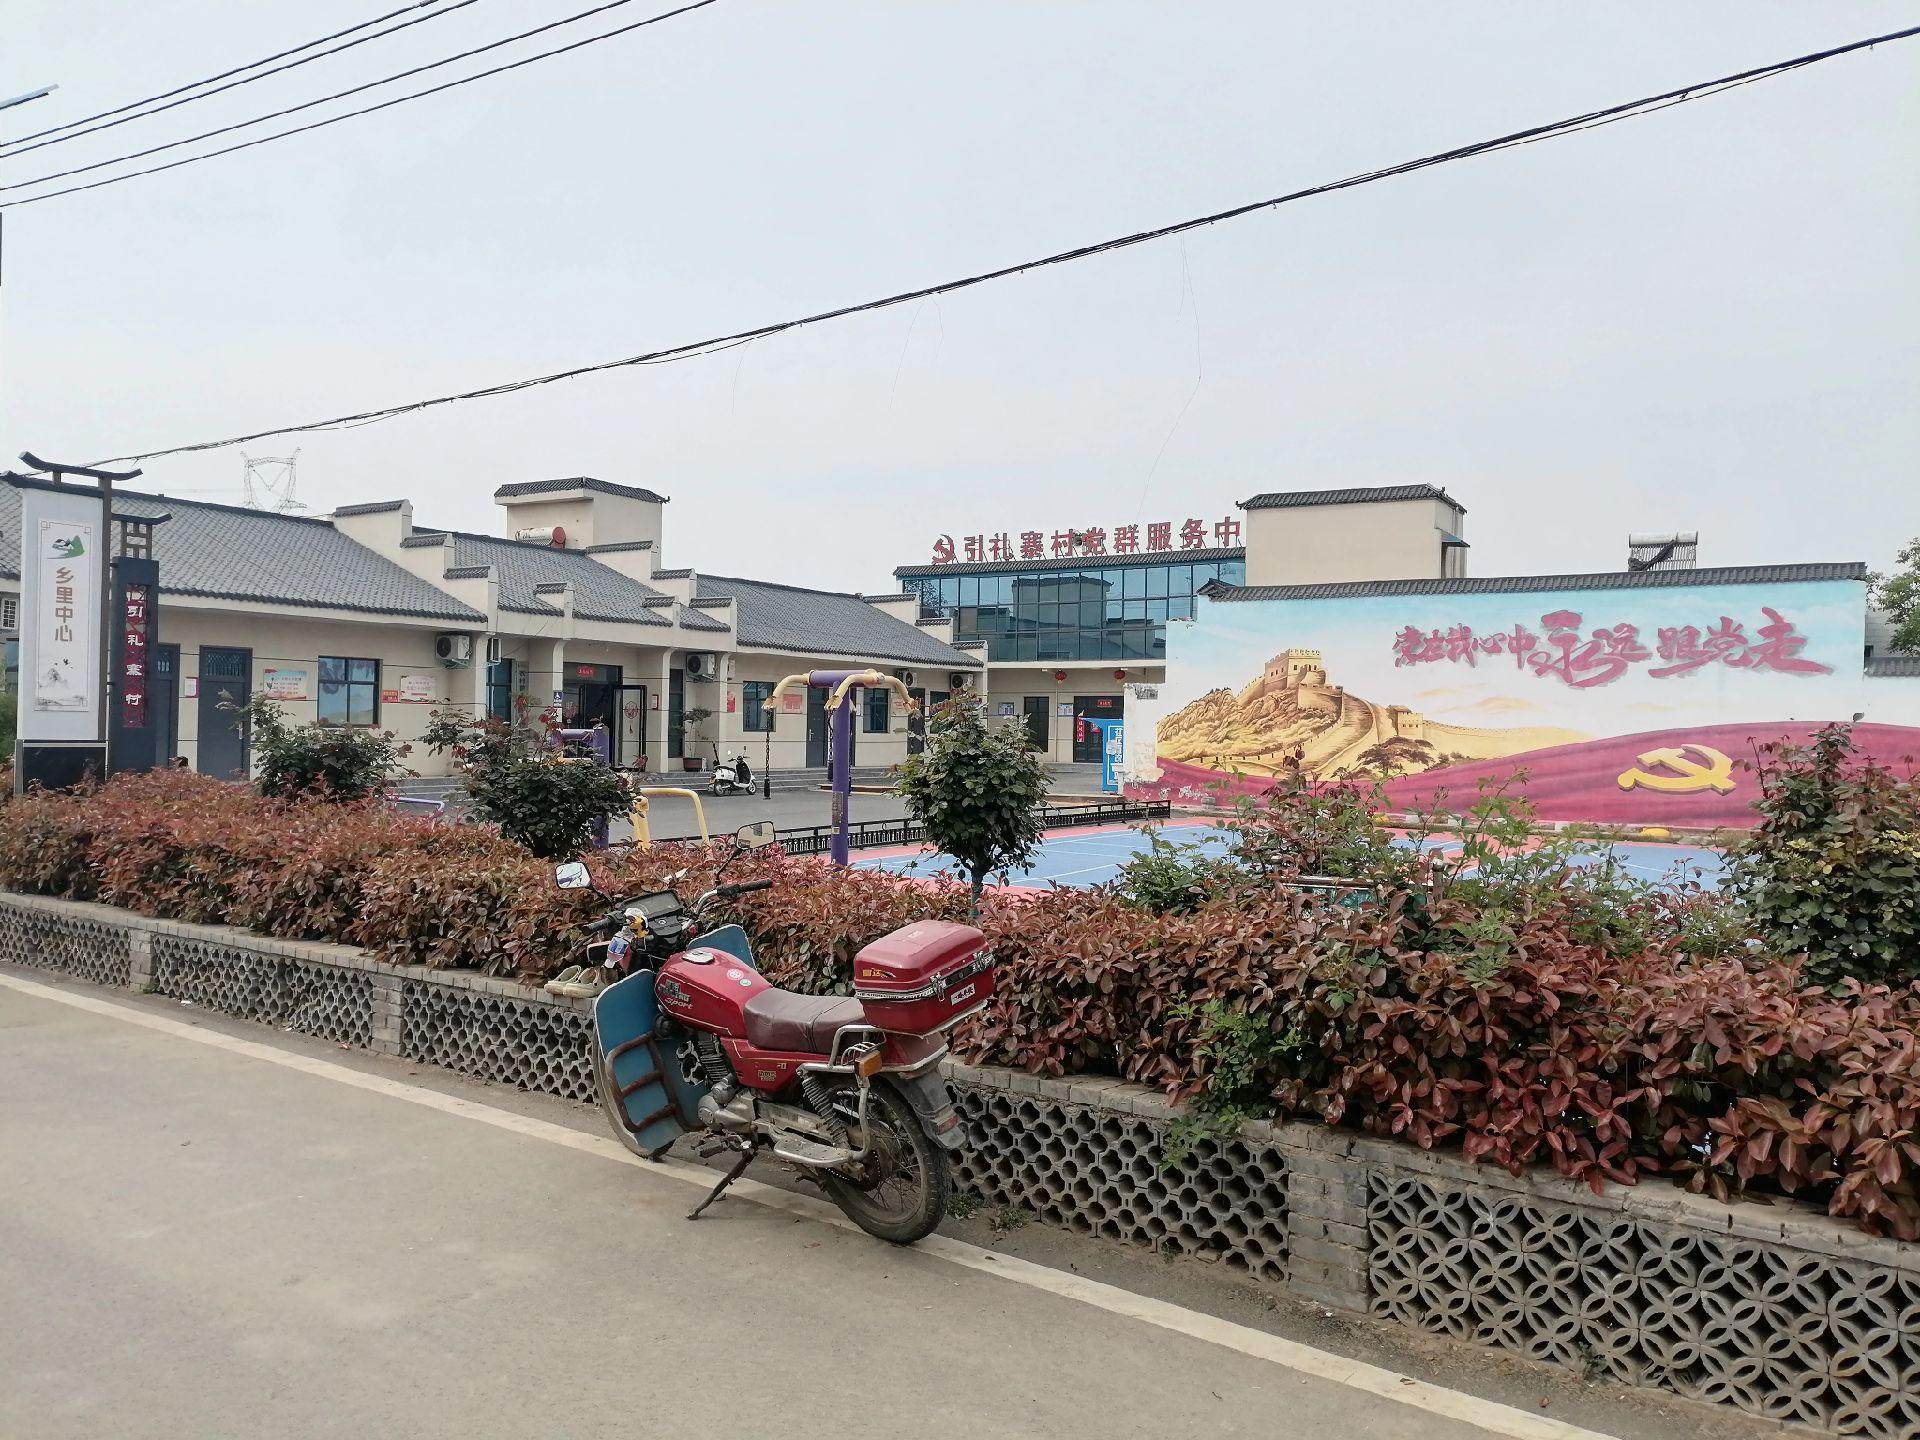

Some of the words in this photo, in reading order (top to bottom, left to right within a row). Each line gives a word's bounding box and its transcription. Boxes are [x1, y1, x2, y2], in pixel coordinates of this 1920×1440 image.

[964, 516, 1241, 562] 引礼寨村党群服务中
[55, 566, 74, 643] 乡里中心
[664, 997, 694, 1010] Sport
